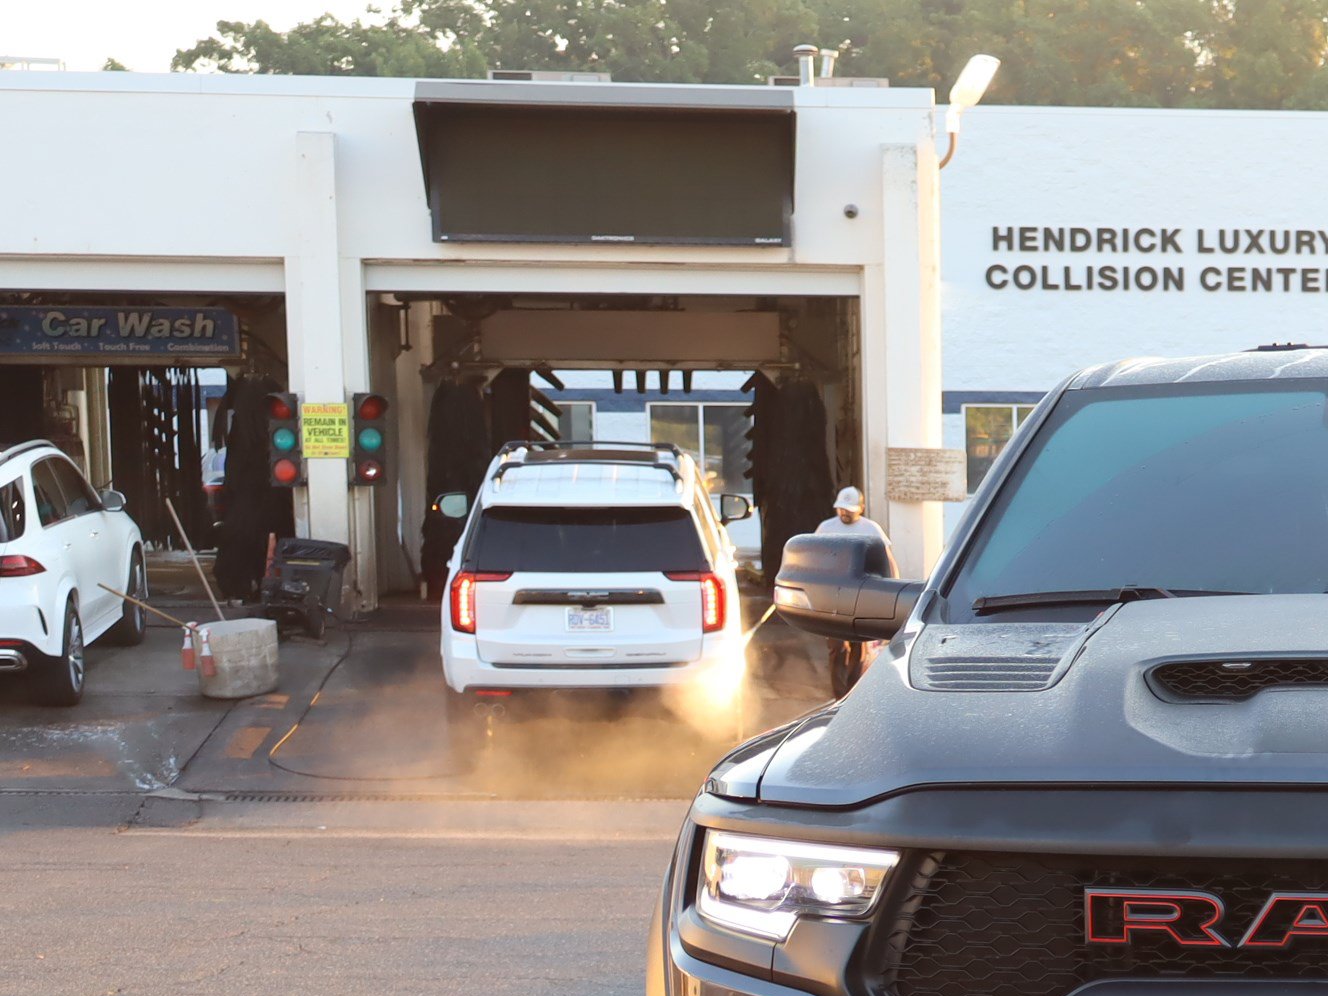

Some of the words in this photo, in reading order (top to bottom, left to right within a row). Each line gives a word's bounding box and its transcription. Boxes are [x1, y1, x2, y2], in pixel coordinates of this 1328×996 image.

[992, 226, 1183, 253] HENDRICK
[985, 264, 1184, 291] COLLISION
[41, 311, 106, 337] Car
[117, 311, 215, 338] Wash
[32, 342, 51, 351] Soft
[53, 342, 82, 351] Touch
[99, 342, 127, 351] Touch
[129, 343, 151, 351] Free
[167, 342, 229, 352] Combination
[303, 417, 336, 426] REMAIN
[338, 417, 347, 426] IN
[307, 427, 343, 437] VEHICLE
